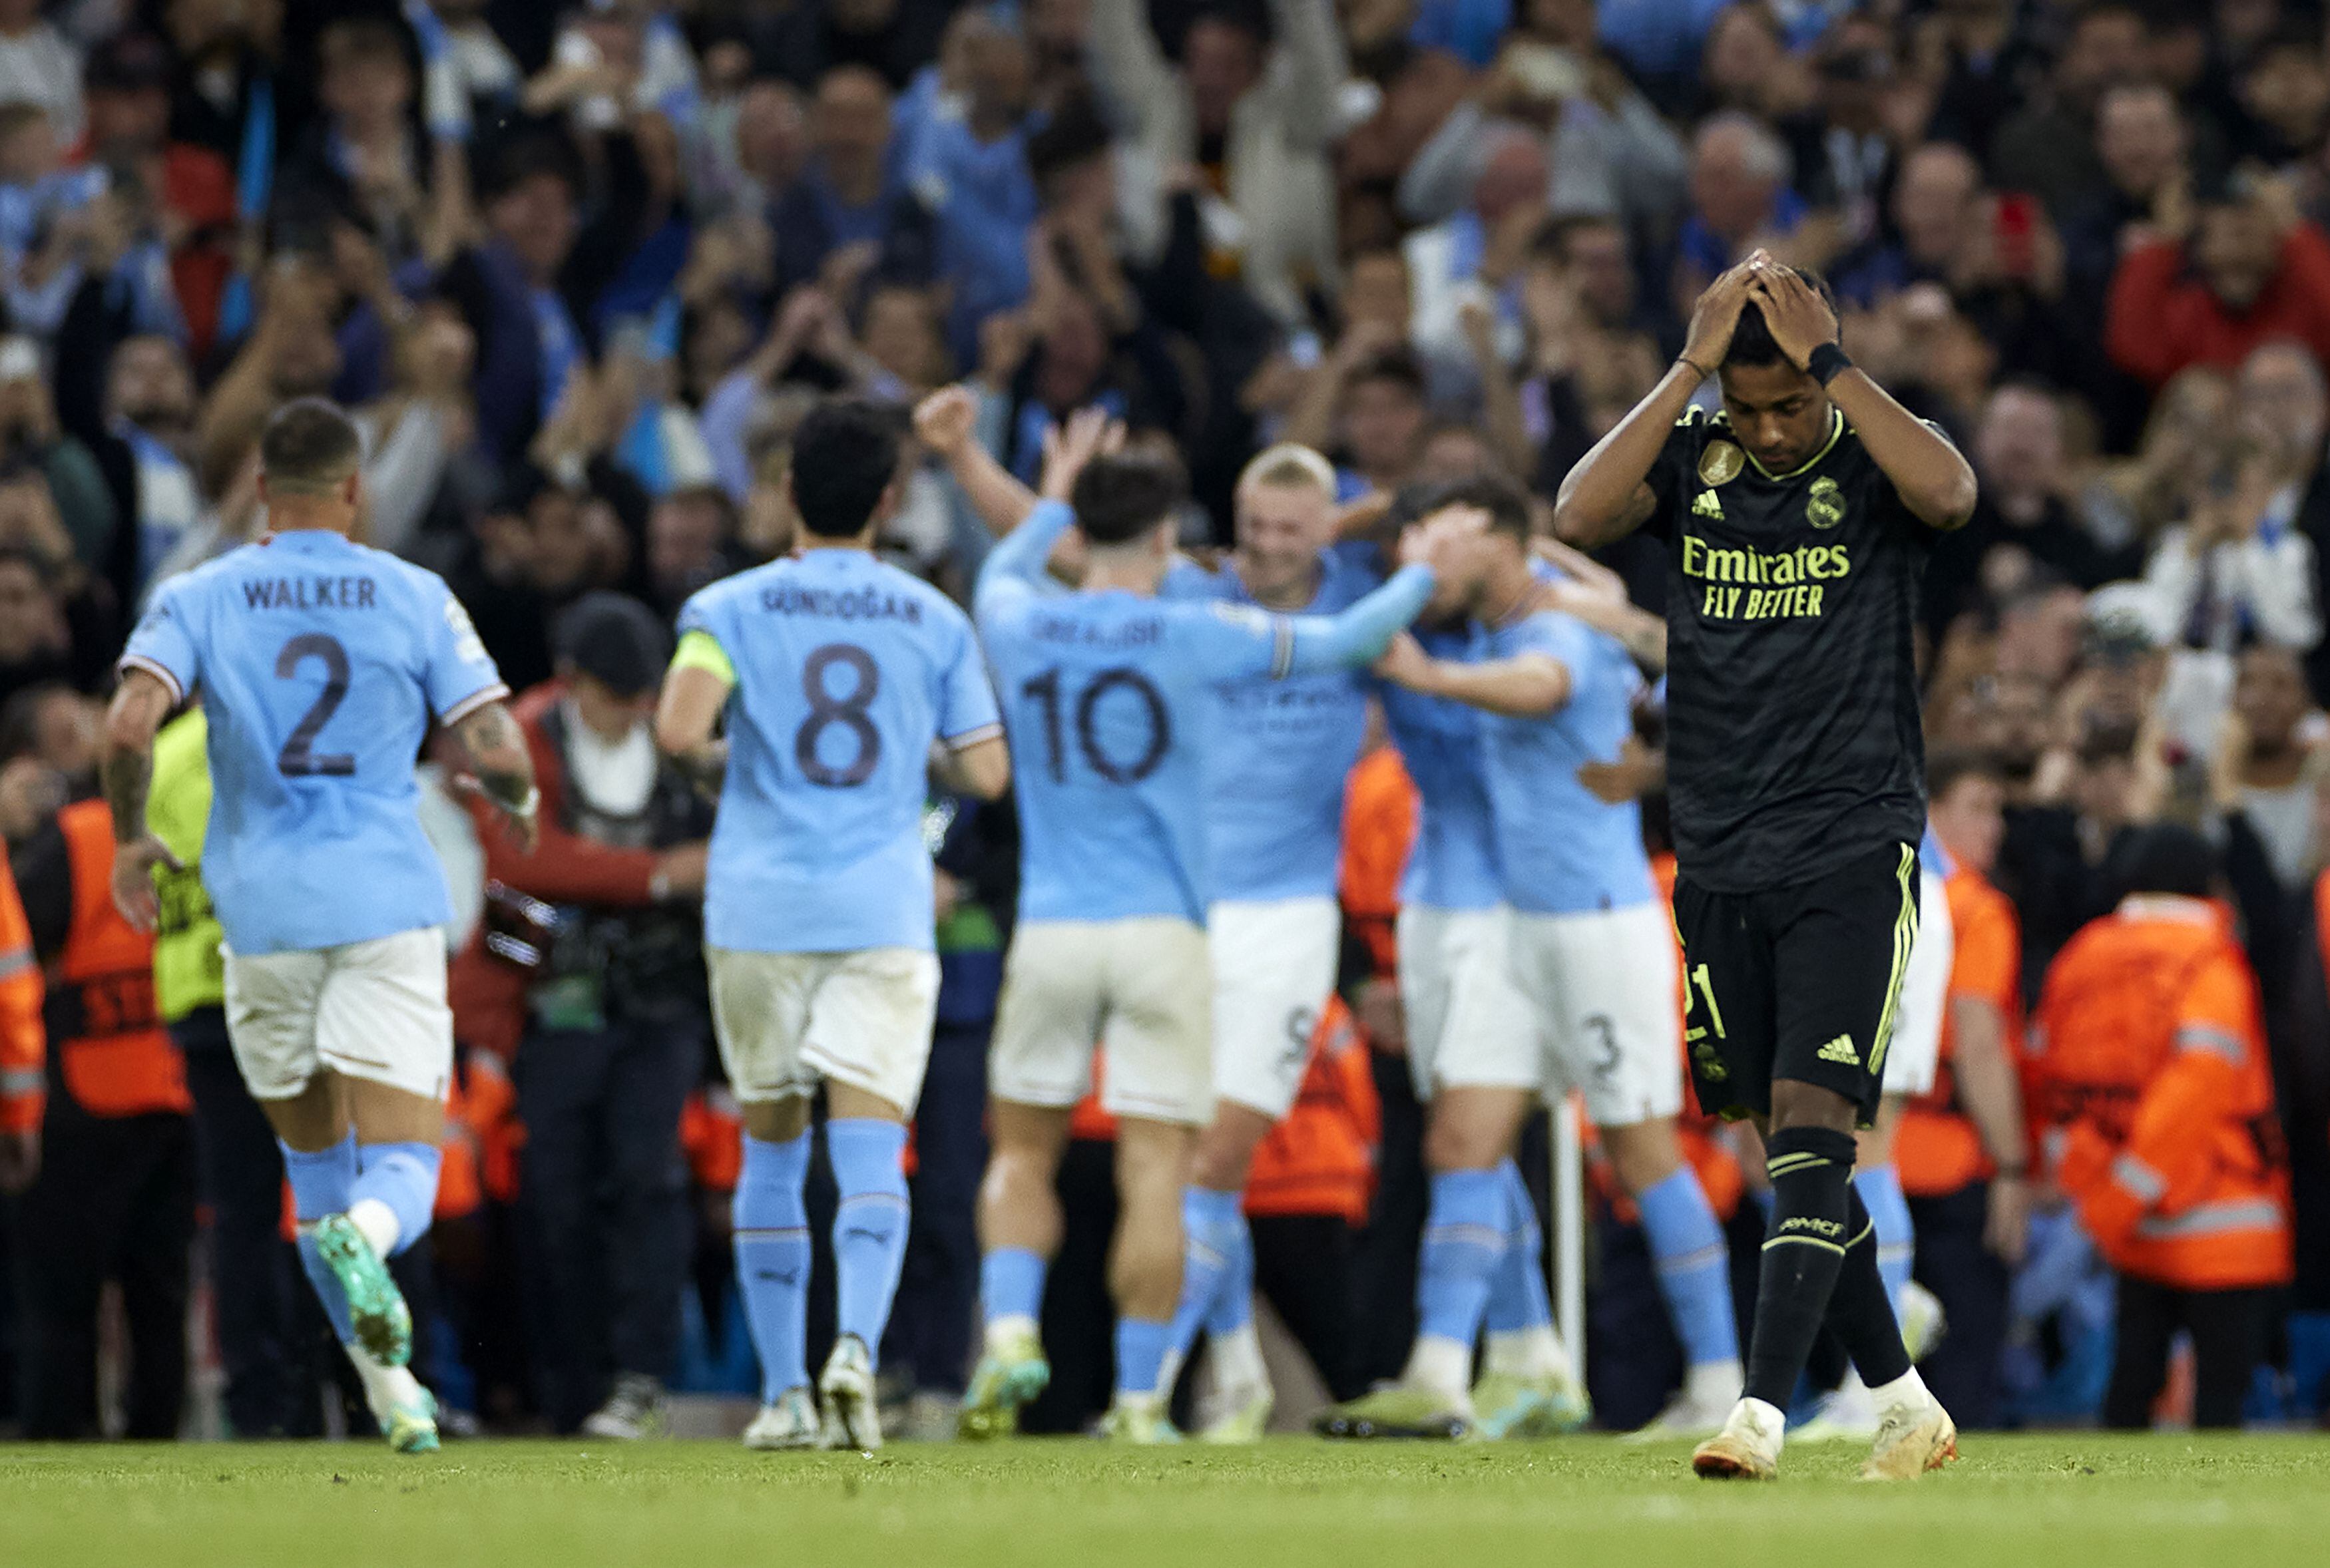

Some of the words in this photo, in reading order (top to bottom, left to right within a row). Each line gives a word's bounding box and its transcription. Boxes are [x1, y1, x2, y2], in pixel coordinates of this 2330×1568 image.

[1683, 535, 1850, 584] Emirates
[243, 577, 376, 608] WALKER
[1702, 585, 1742, 619] FLY
[1744, 584, 1823, 620] BETTER
[274, 633, 357, 777] 2
[796, 642, 881, 789] 8
[1022, 666, 1171, 785] 10
[1581, 1013, 1622, 1078] 3
